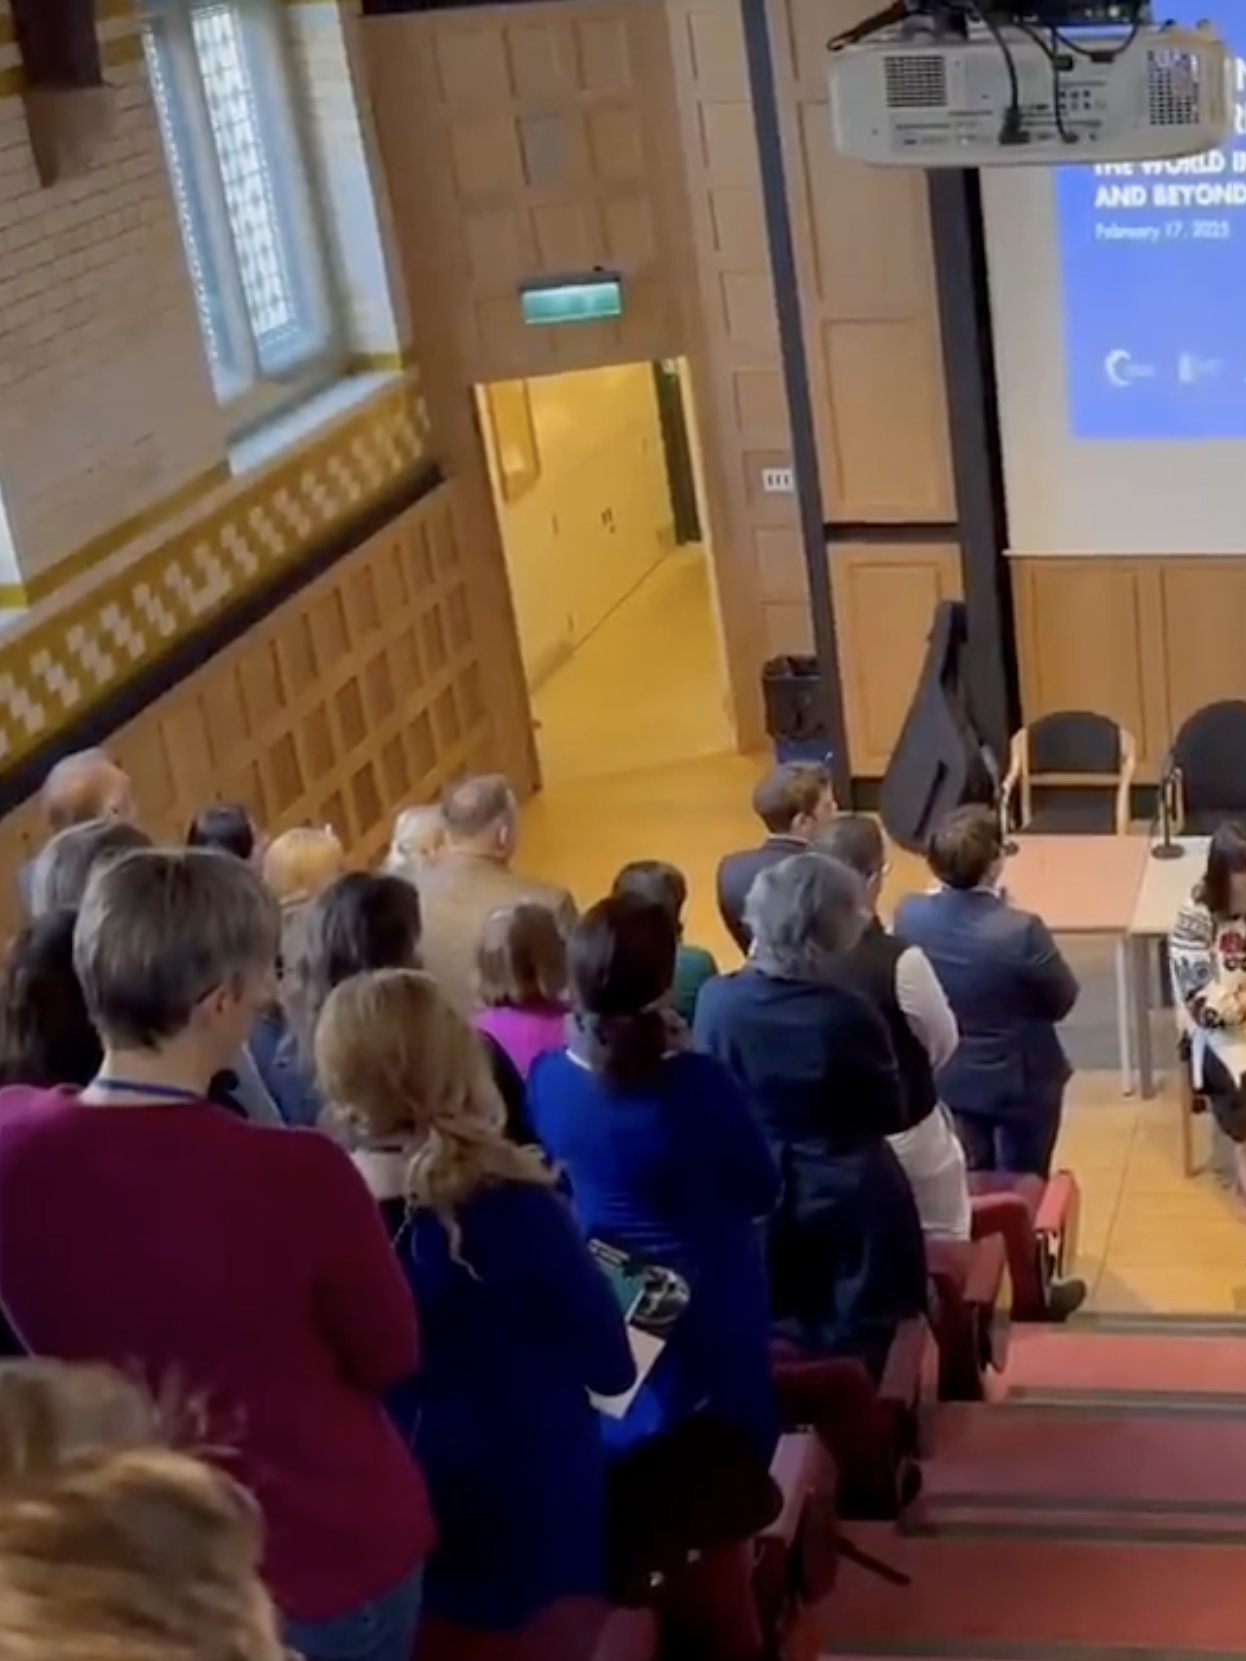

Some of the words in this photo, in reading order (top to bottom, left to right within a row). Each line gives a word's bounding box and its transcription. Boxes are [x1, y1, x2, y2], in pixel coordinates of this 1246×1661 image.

[1141, 151, 1225, 175] WORLD
[1095, 184, 1147, 207] AND
[1096, 222, 1160, 242] February
[1193, 220, 1230, 238] 2025
